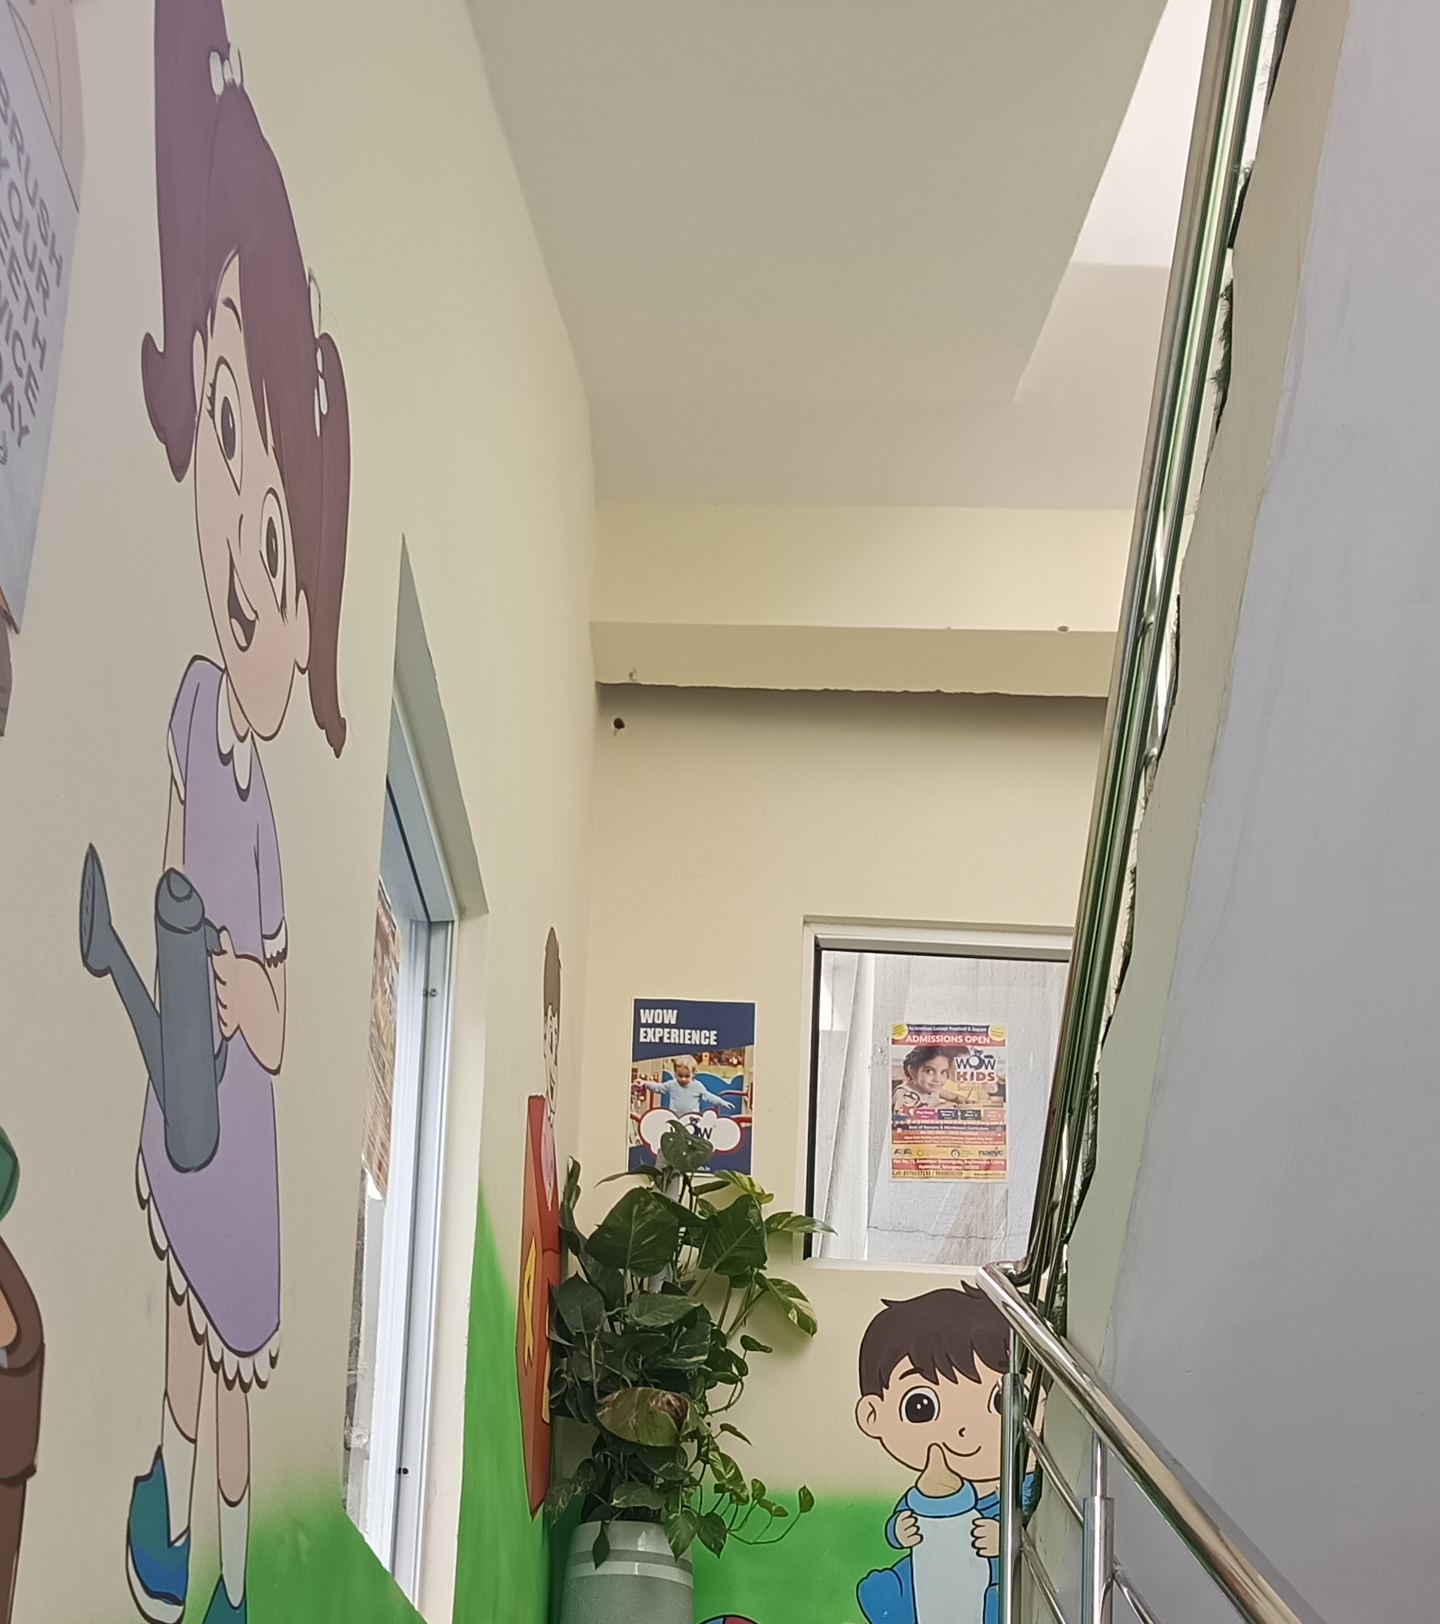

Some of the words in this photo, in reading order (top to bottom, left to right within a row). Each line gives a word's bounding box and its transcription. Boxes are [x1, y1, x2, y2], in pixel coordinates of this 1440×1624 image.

[639, 1008, 678, 1025] WOW
[639, 1027, 718, 1046] EXPERIENCE
[906, 1035, 964, 1043] ADMISSIONS
[965, 1035, 990, 1044] OPEN
[956, 1056, 996, 1070] WOW
[956, 1071, 995, 1081] KIDS
